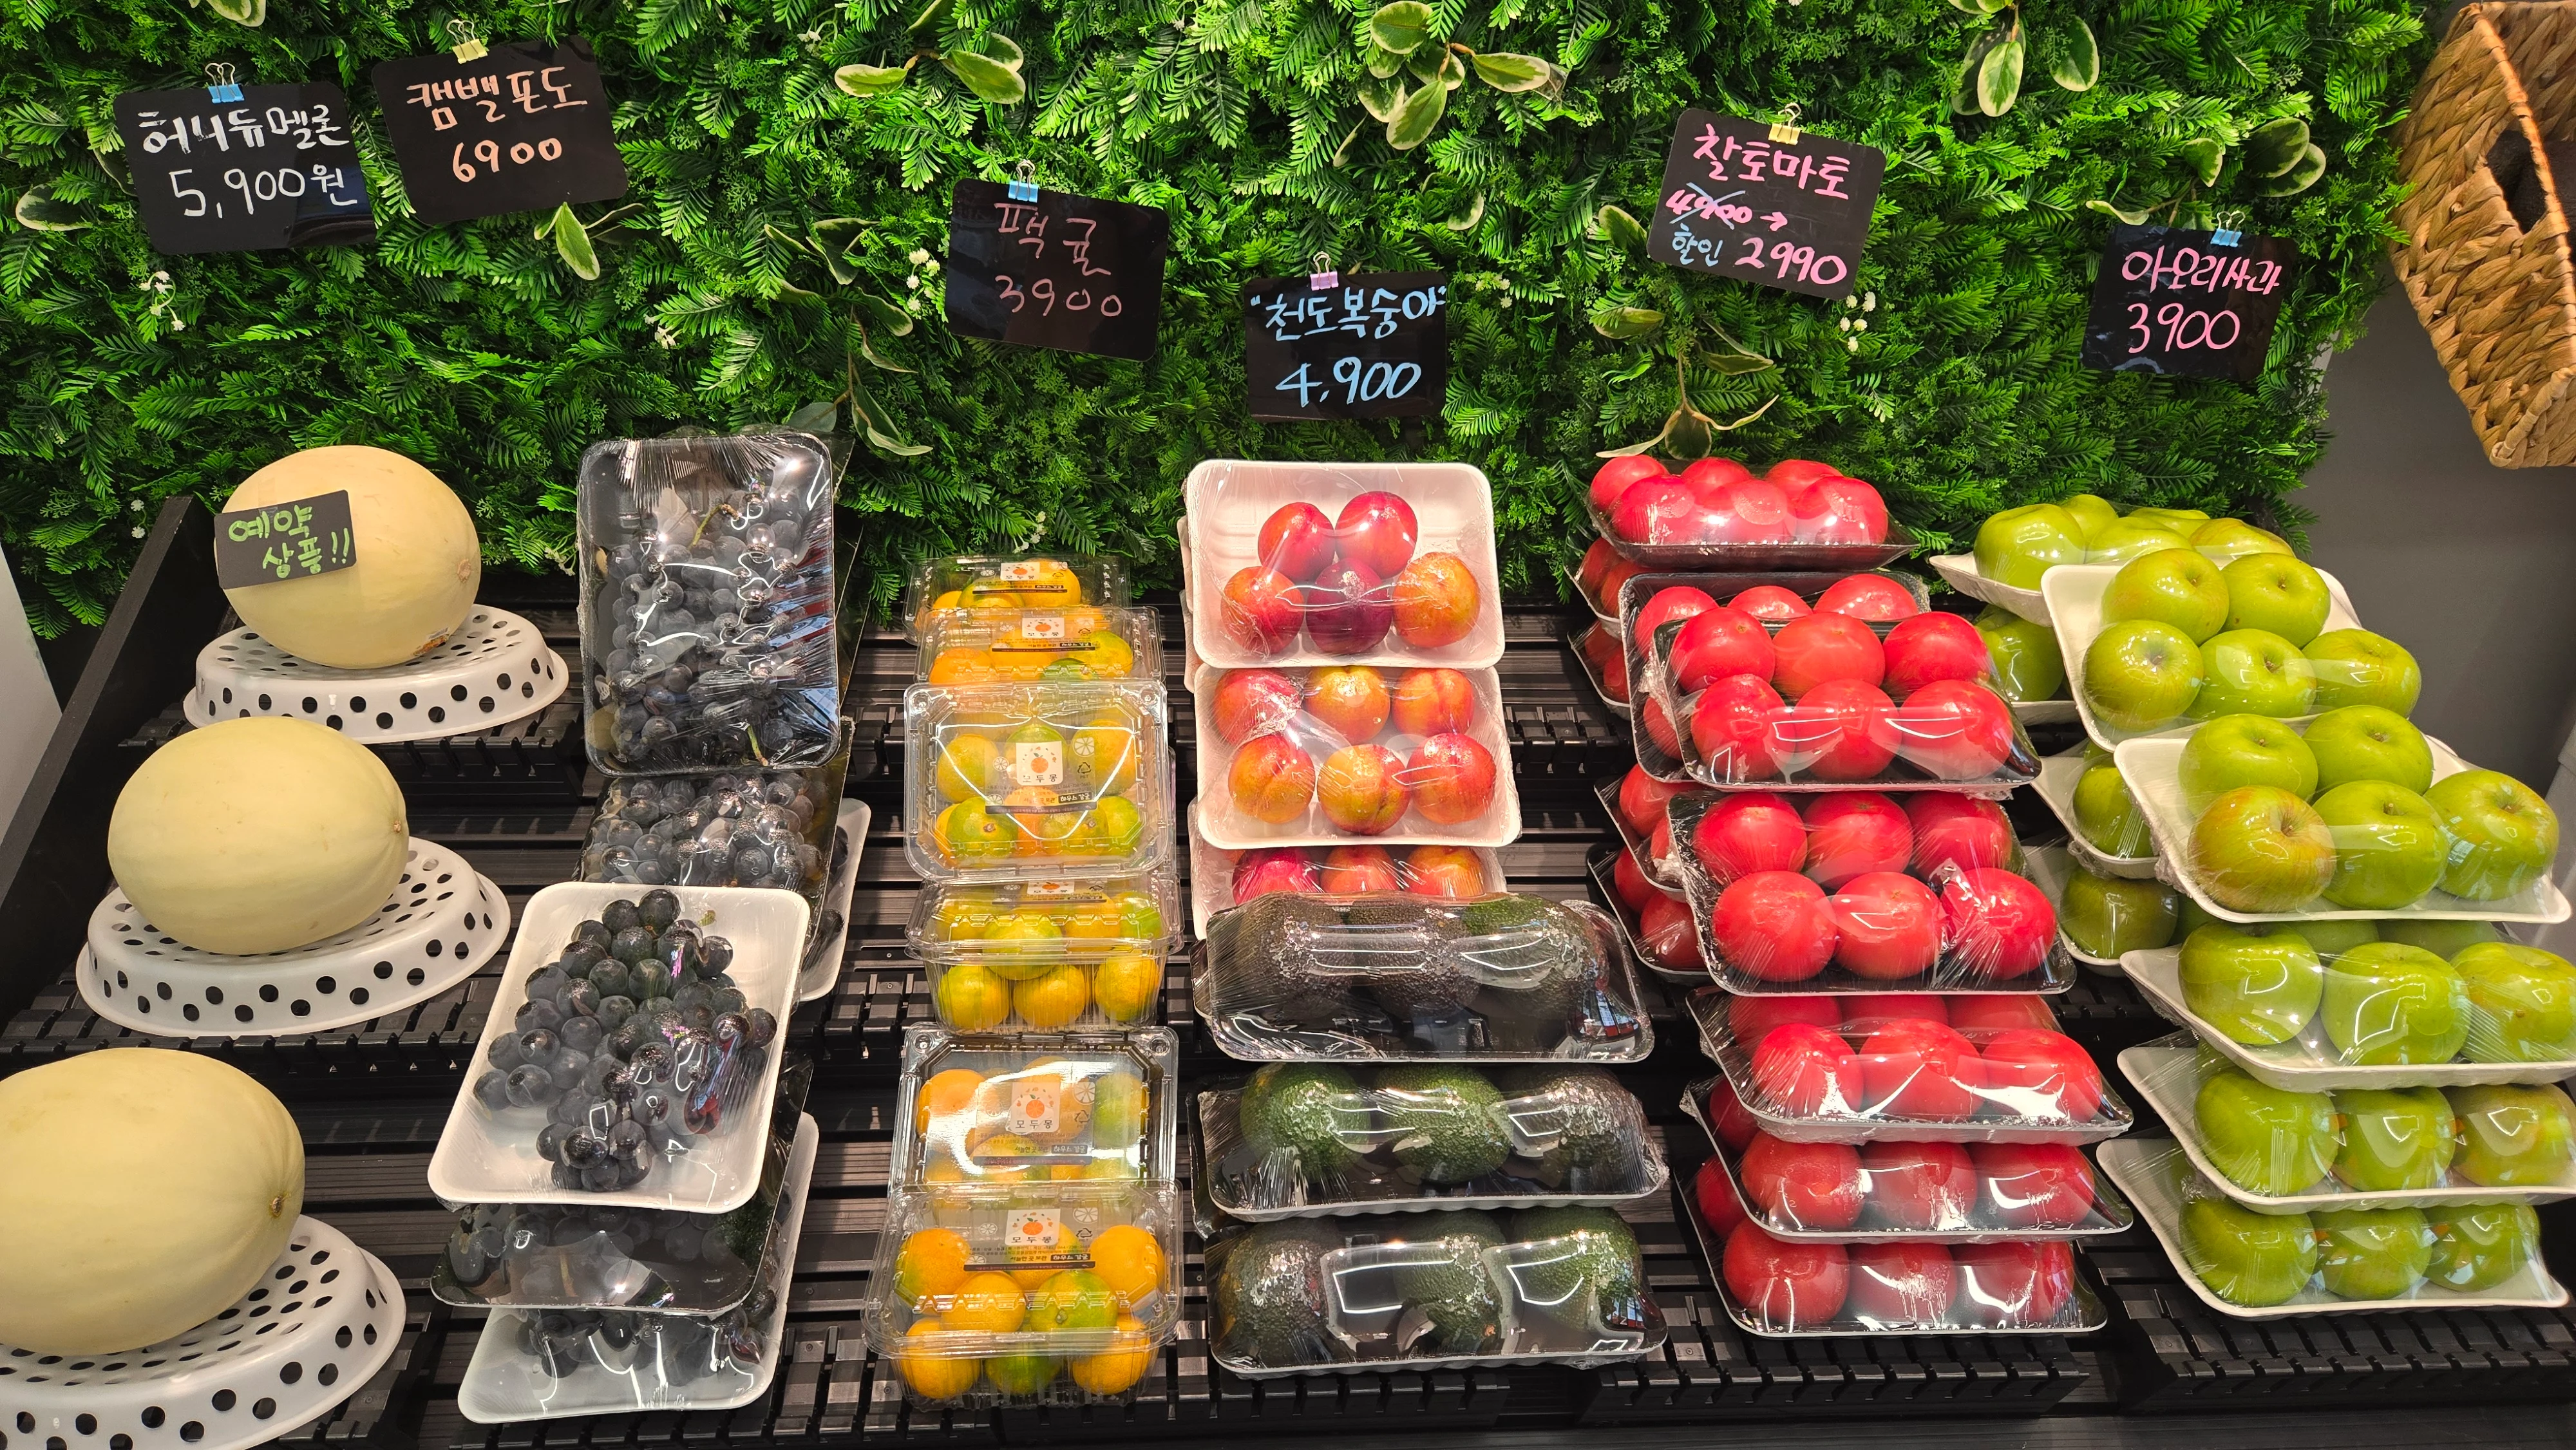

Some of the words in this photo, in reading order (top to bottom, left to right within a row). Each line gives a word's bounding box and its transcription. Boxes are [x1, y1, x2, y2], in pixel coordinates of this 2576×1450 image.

[452, 138, 562, 182] 6900
[1692, 123, 1851, 200] 찰토마토
[1672, 223, 1723, 267] 할인
[1734, 237, 1848, 285] 2990
[995, 276, 1122, 316] 3900
[2127, 303, 2240, 353] 3900
[1274, 357, 1421, 408] 4,900
[229, 504, 312, 541] 예약
